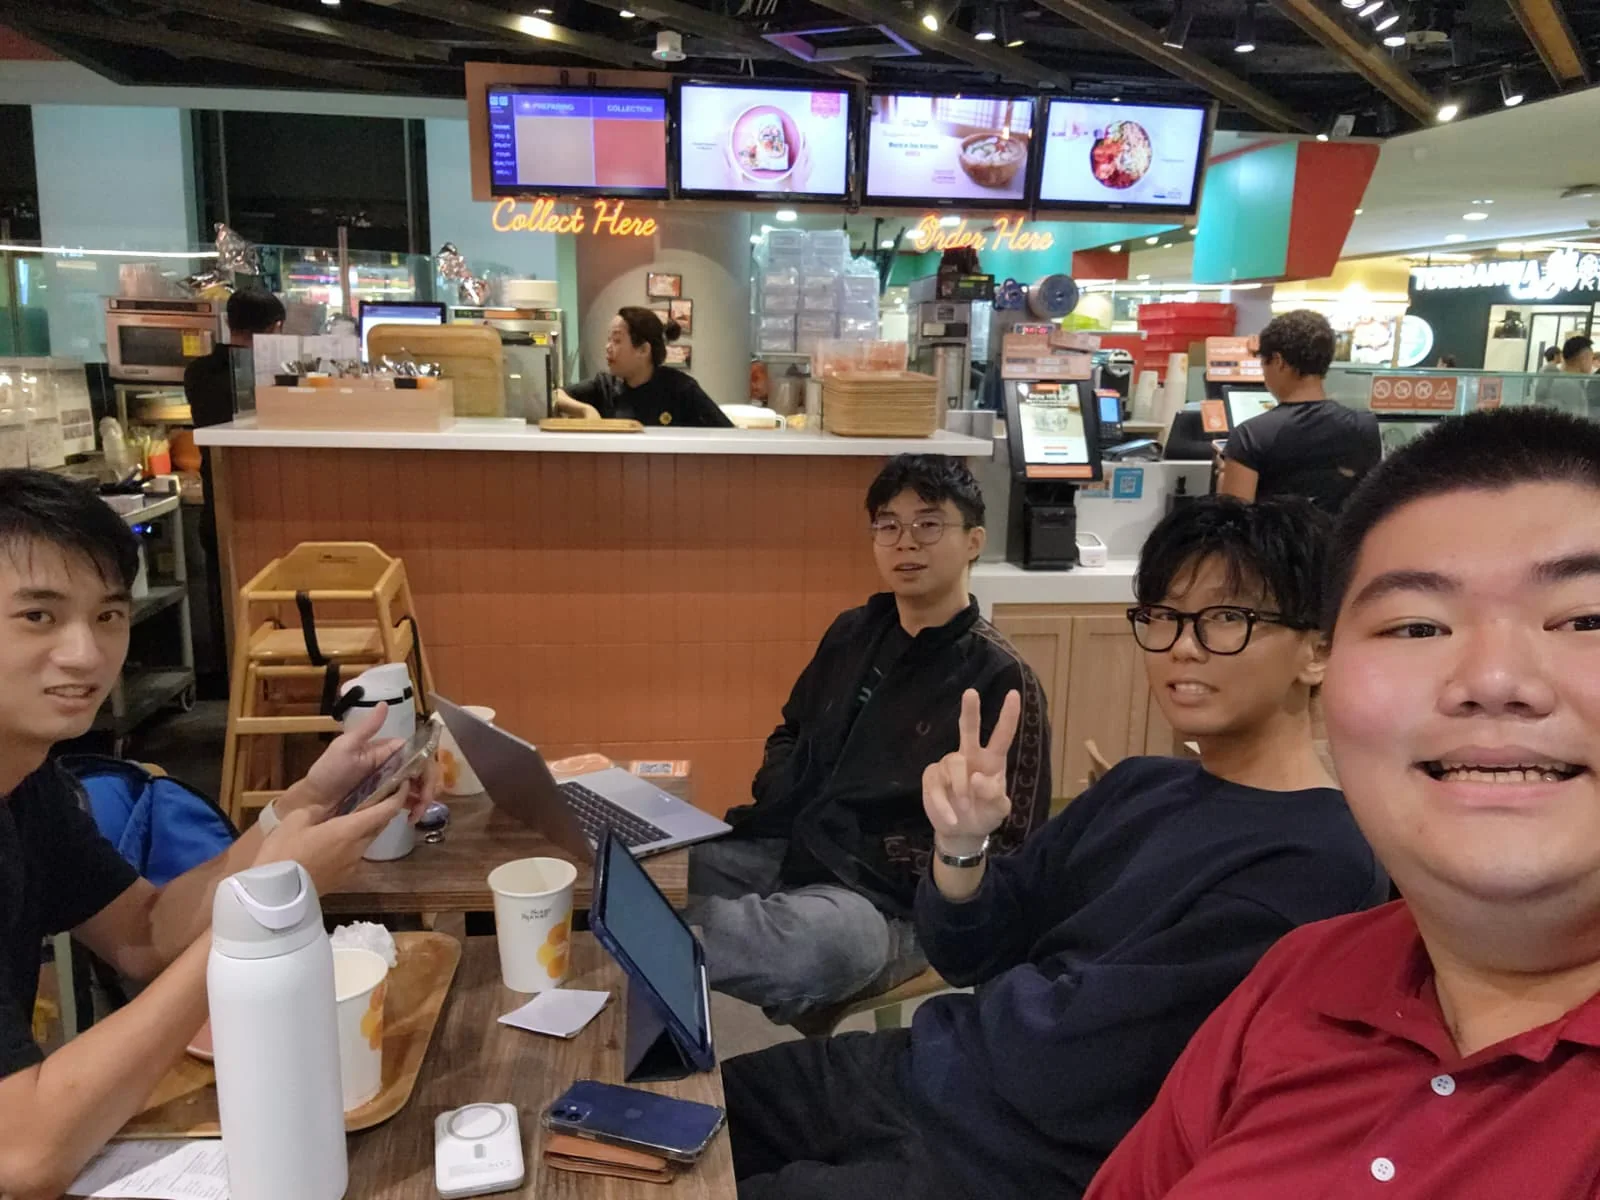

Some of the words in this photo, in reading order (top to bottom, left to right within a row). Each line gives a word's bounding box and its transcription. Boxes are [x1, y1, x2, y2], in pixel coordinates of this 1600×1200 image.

[606, 104, 653, 113] COLLECTION
[492, 197, 584, 232] Collect
[593, 200, 656, 236] Here
[913, 214, 986, 252] Order
[990, 216, 1055, 251] Here
